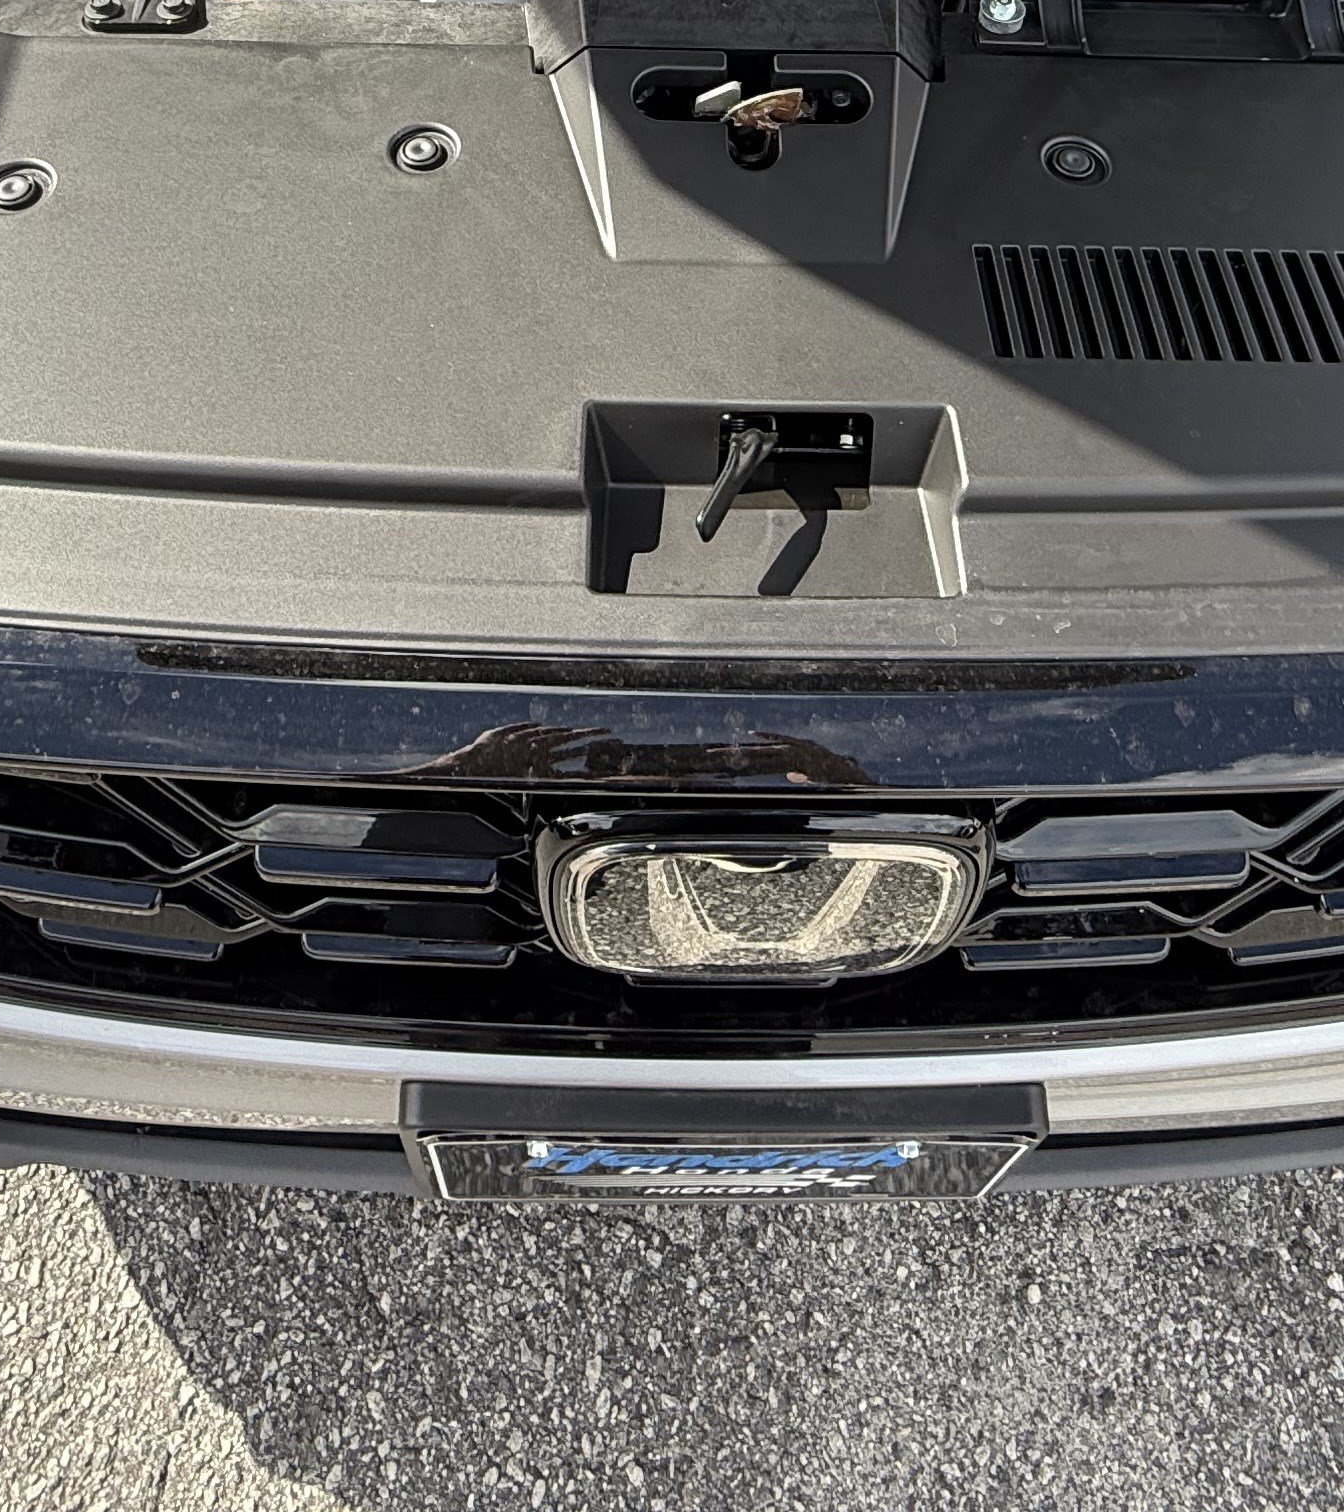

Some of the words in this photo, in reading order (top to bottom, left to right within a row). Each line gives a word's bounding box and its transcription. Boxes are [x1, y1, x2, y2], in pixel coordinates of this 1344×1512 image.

[522, 1147, 910, 1174] Hendrick
[621, 1165, 836, 1176] Honda
[643, 1186, 804, 1196] HICKORY
